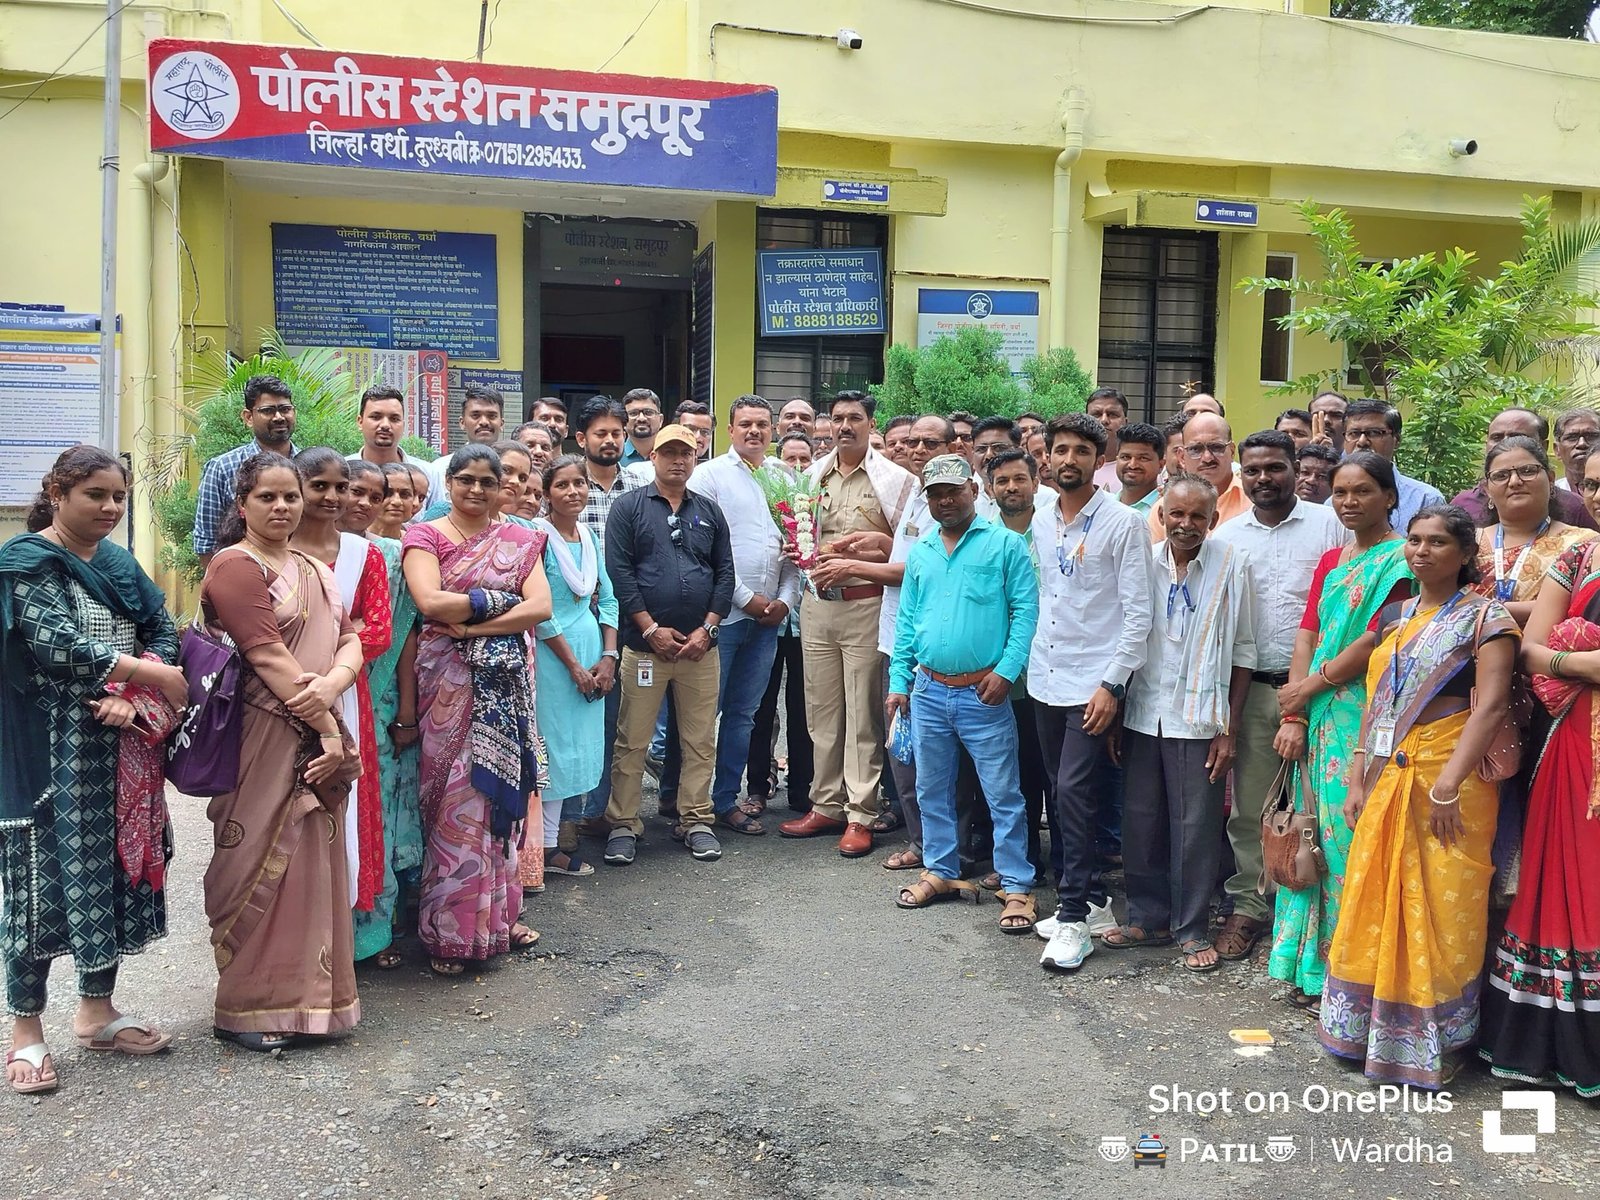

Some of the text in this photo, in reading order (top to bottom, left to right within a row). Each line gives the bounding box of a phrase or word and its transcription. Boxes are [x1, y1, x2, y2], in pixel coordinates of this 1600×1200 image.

[250, 52, 710, 157] पोलीस स्टेशन समुद्रपूर
[336, 227, 437, 242] पोलीस अधीक्षक, वर्धा
[343, 240, 387, 250] नागरिकांना
[777, 254, 864, 270] तक्रारदारांचे समाधान
[765, 274, 773, 284] न
[775, 273, 812, 285] झाल्यास
[814, 270, 847, 284] ठाणेदार
[798, 284, 847, 298] यांना भेटावे
[768, 297, 878, 314] पोलीस स्टेशन अधिकारी
[772, 313, 878, 329] M: 8888188529
[431, 375, 445, 394] वर्धा
[431, 394, 445, 421] जिल्हा
